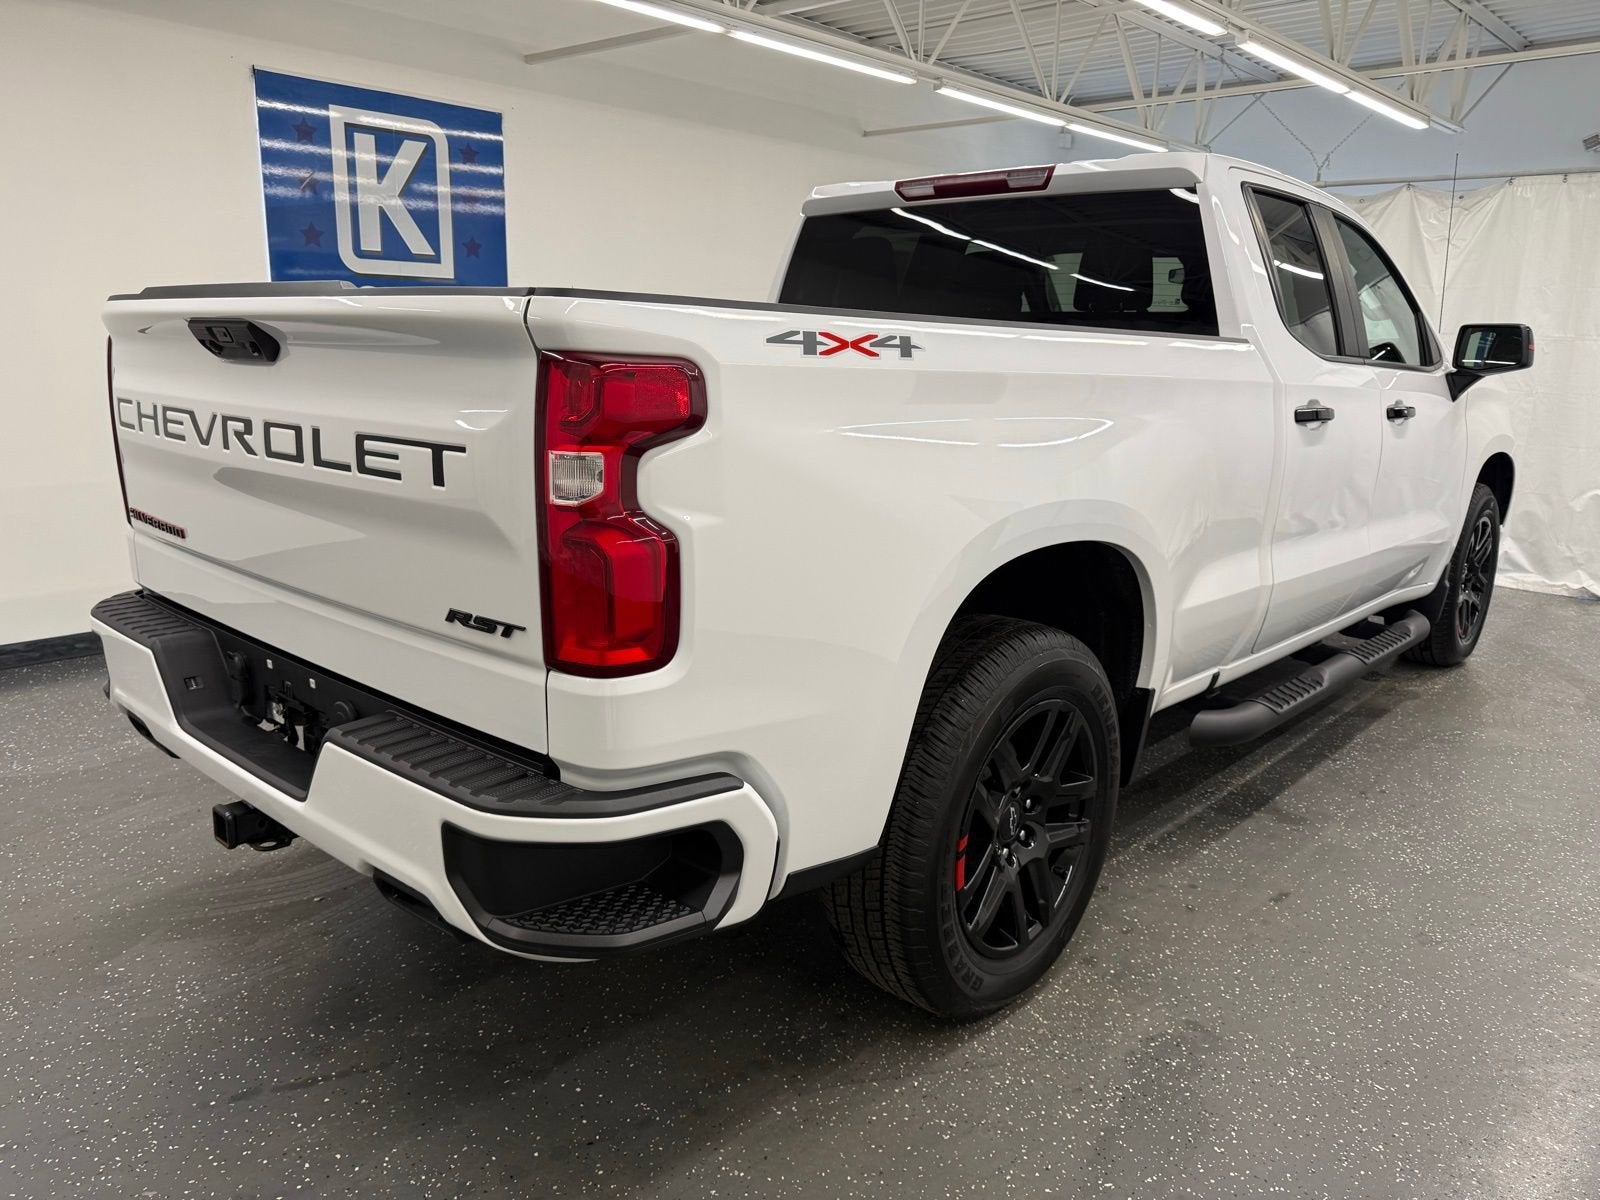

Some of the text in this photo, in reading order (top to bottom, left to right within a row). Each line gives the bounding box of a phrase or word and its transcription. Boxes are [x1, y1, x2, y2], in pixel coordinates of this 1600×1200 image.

[354, 132, 435, 255] K
[117, 397, 467, 487] CHEVROLET
[130, 507, 187, 539] SILVERADO
[445, 608, 526, 638] RST
